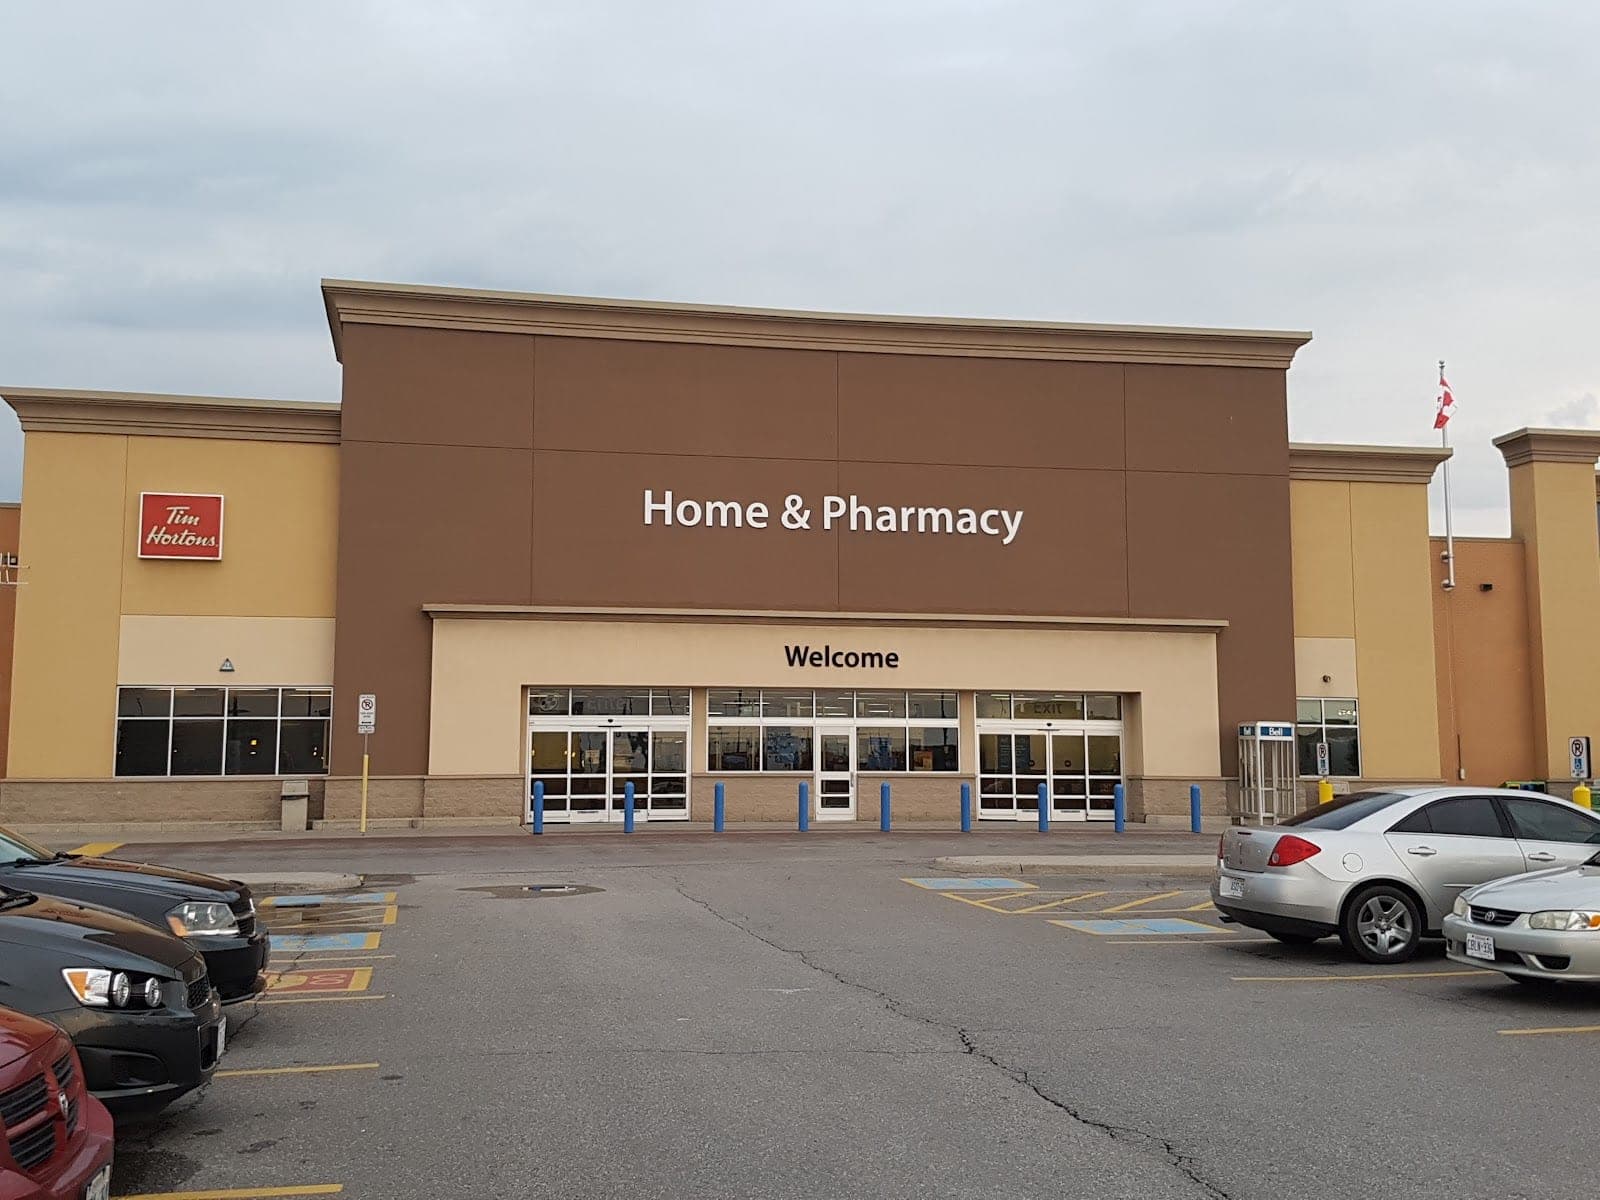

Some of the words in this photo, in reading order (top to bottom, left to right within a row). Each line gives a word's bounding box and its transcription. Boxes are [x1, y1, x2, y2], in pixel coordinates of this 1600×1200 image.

[166, 505, 200, 526] Tim
[645, 490, 768, 528] Home
[781, 495, 810, 529] &
[824, 495, 1023, 544] Pharmacy
[145, 525, 216, 547] Hortons
[785, 646, 898, 668] Welcome
[1269, 727, 1283, 736] Bell
